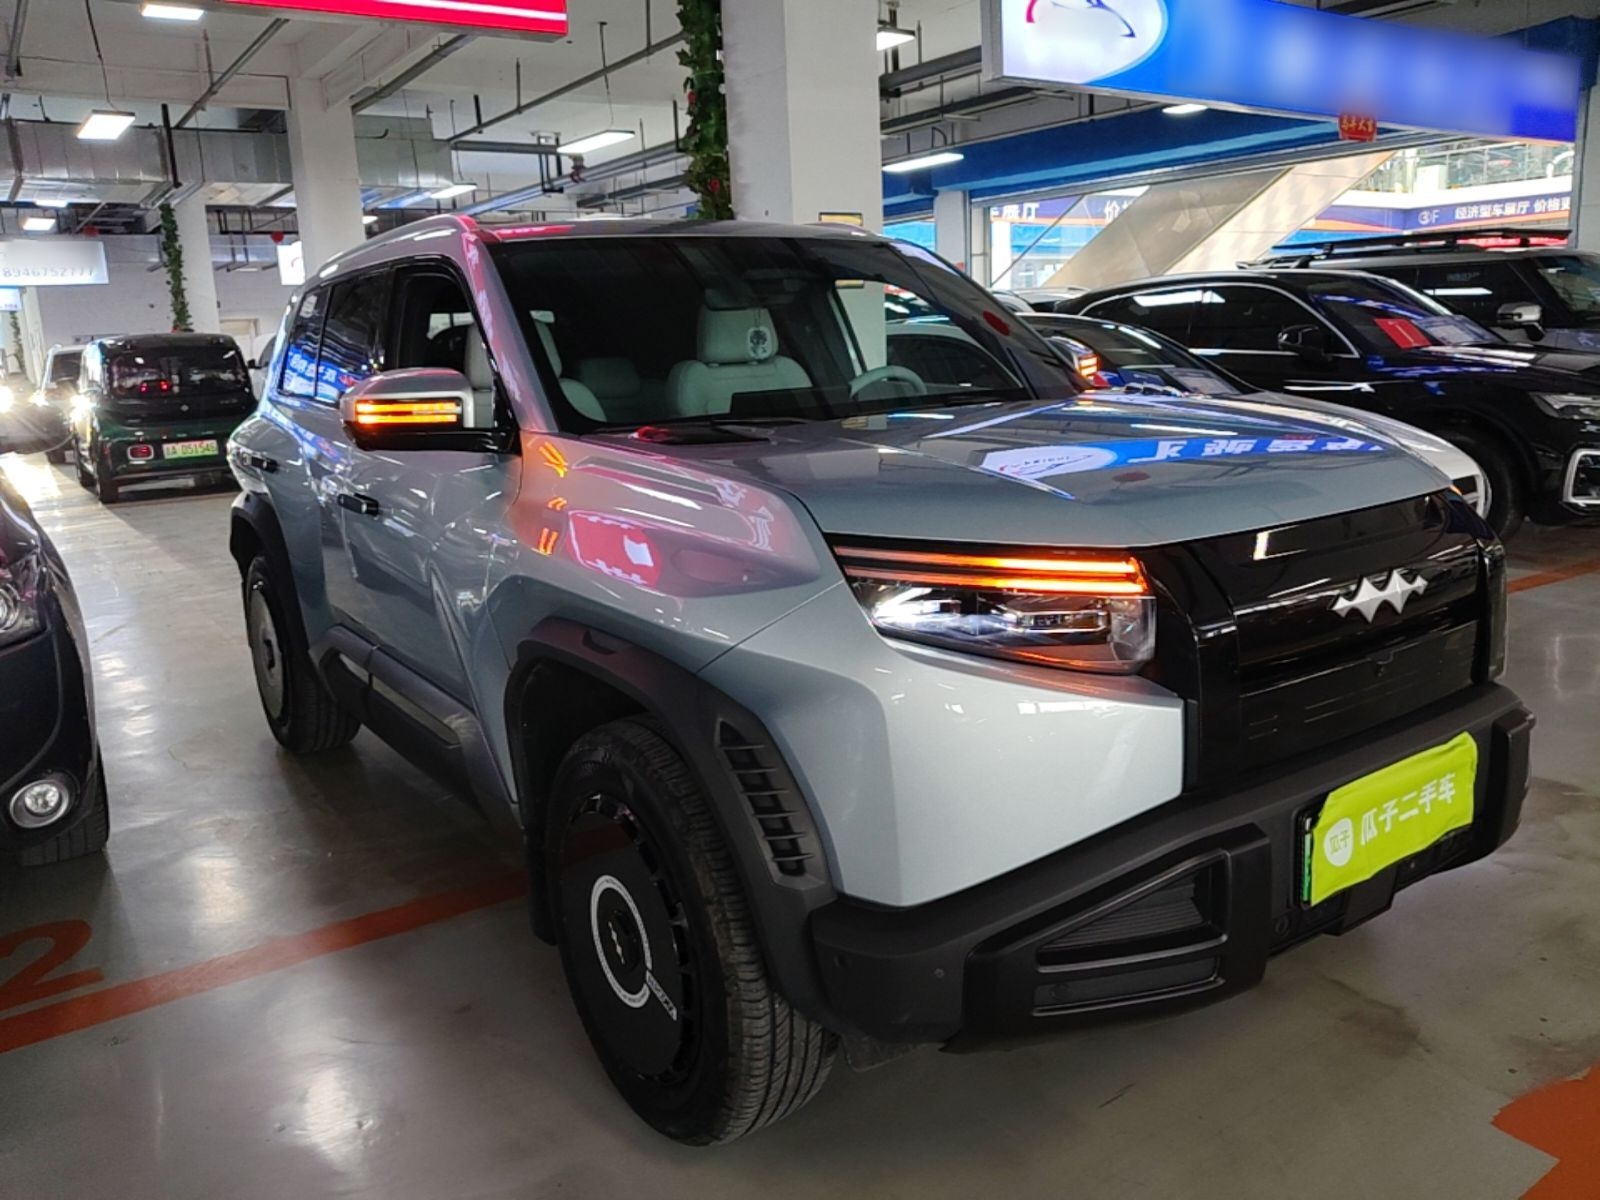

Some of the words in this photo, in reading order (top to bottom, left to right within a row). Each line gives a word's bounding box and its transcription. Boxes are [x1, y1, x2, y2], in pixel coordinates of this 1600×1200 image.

[1455, 200, 1531, 220] 经济型车展厅
[1360, 772, 1456, 846] 瓜子二手车
[0, 919, 104, 1012] 2
